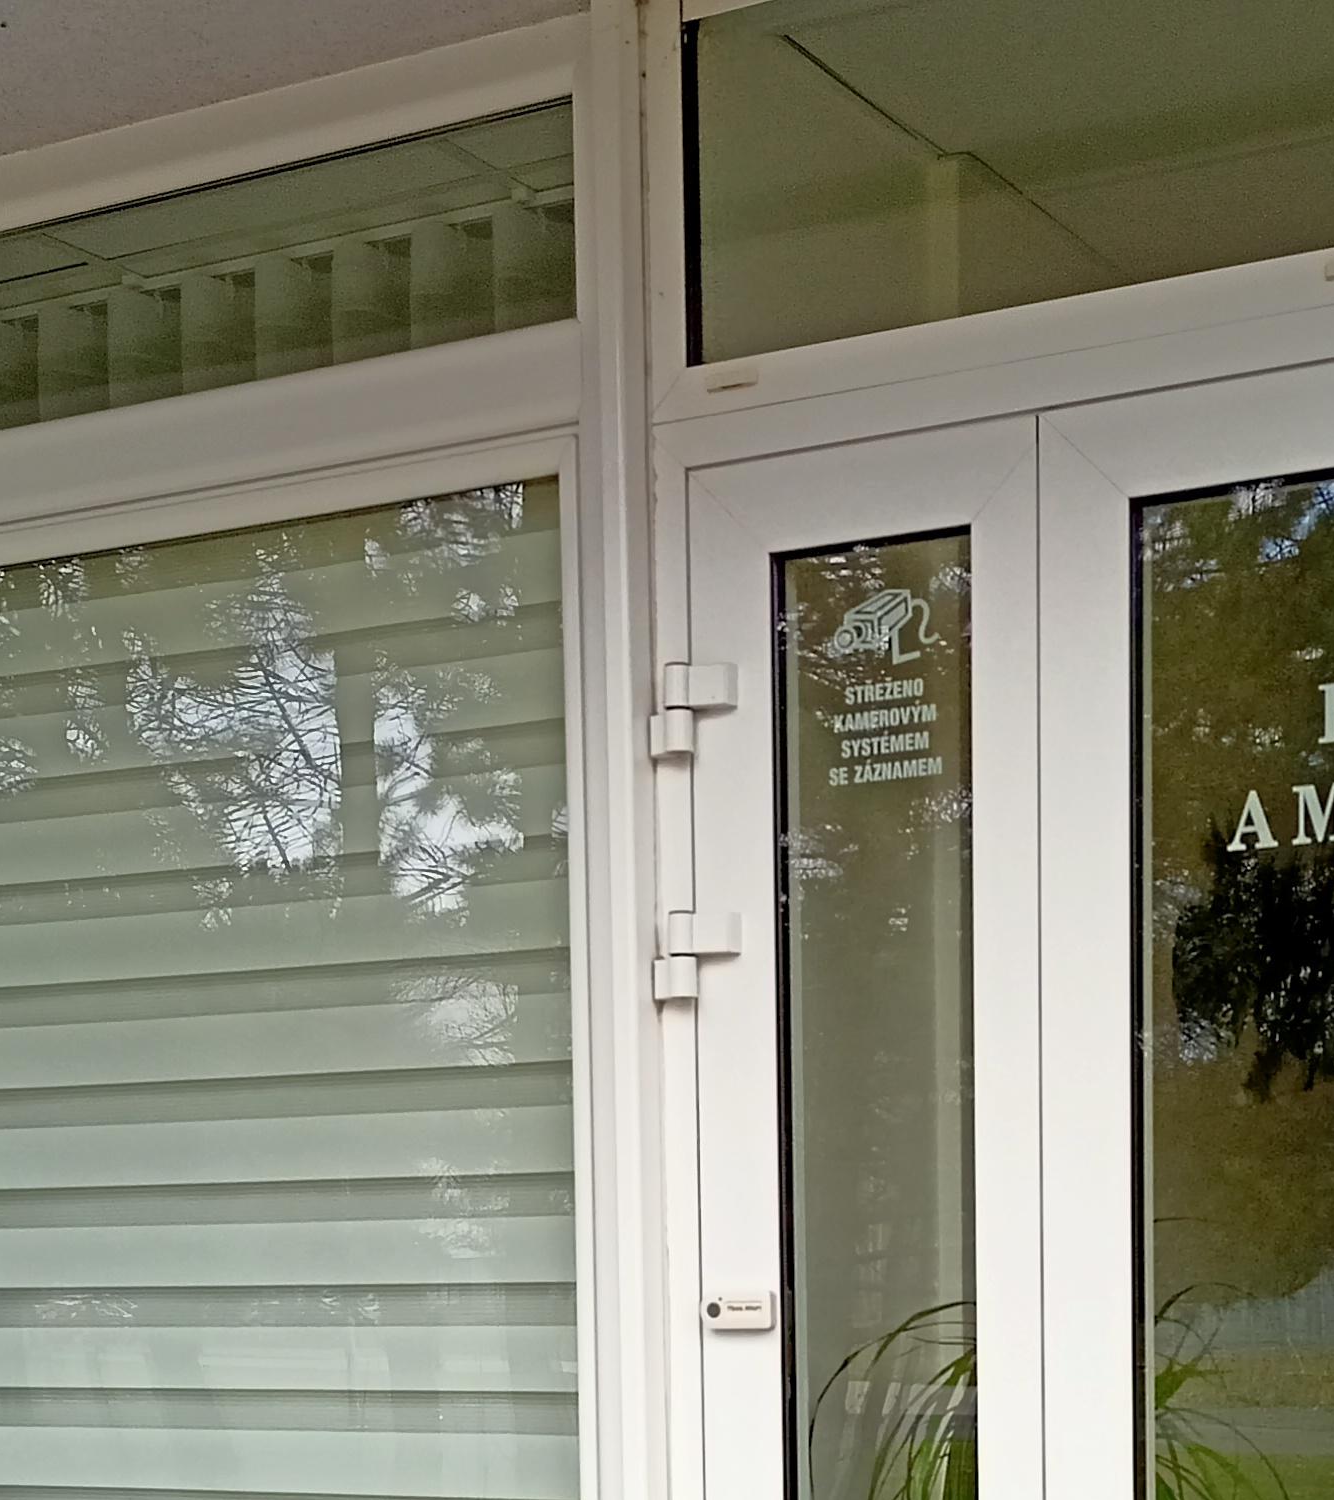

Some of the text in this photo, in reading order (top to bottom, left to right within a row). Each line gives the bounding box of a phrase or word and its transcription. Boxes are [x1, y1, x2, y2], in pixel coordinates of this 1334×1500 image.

[833, 699, 937, 733] KAMEROVÝM
[841, 730, 930, 759] SYSTÉMEM
[829, 756, 943, 787] SE ZÁZNAMEM
[1227, 790, 1279, 853] A
